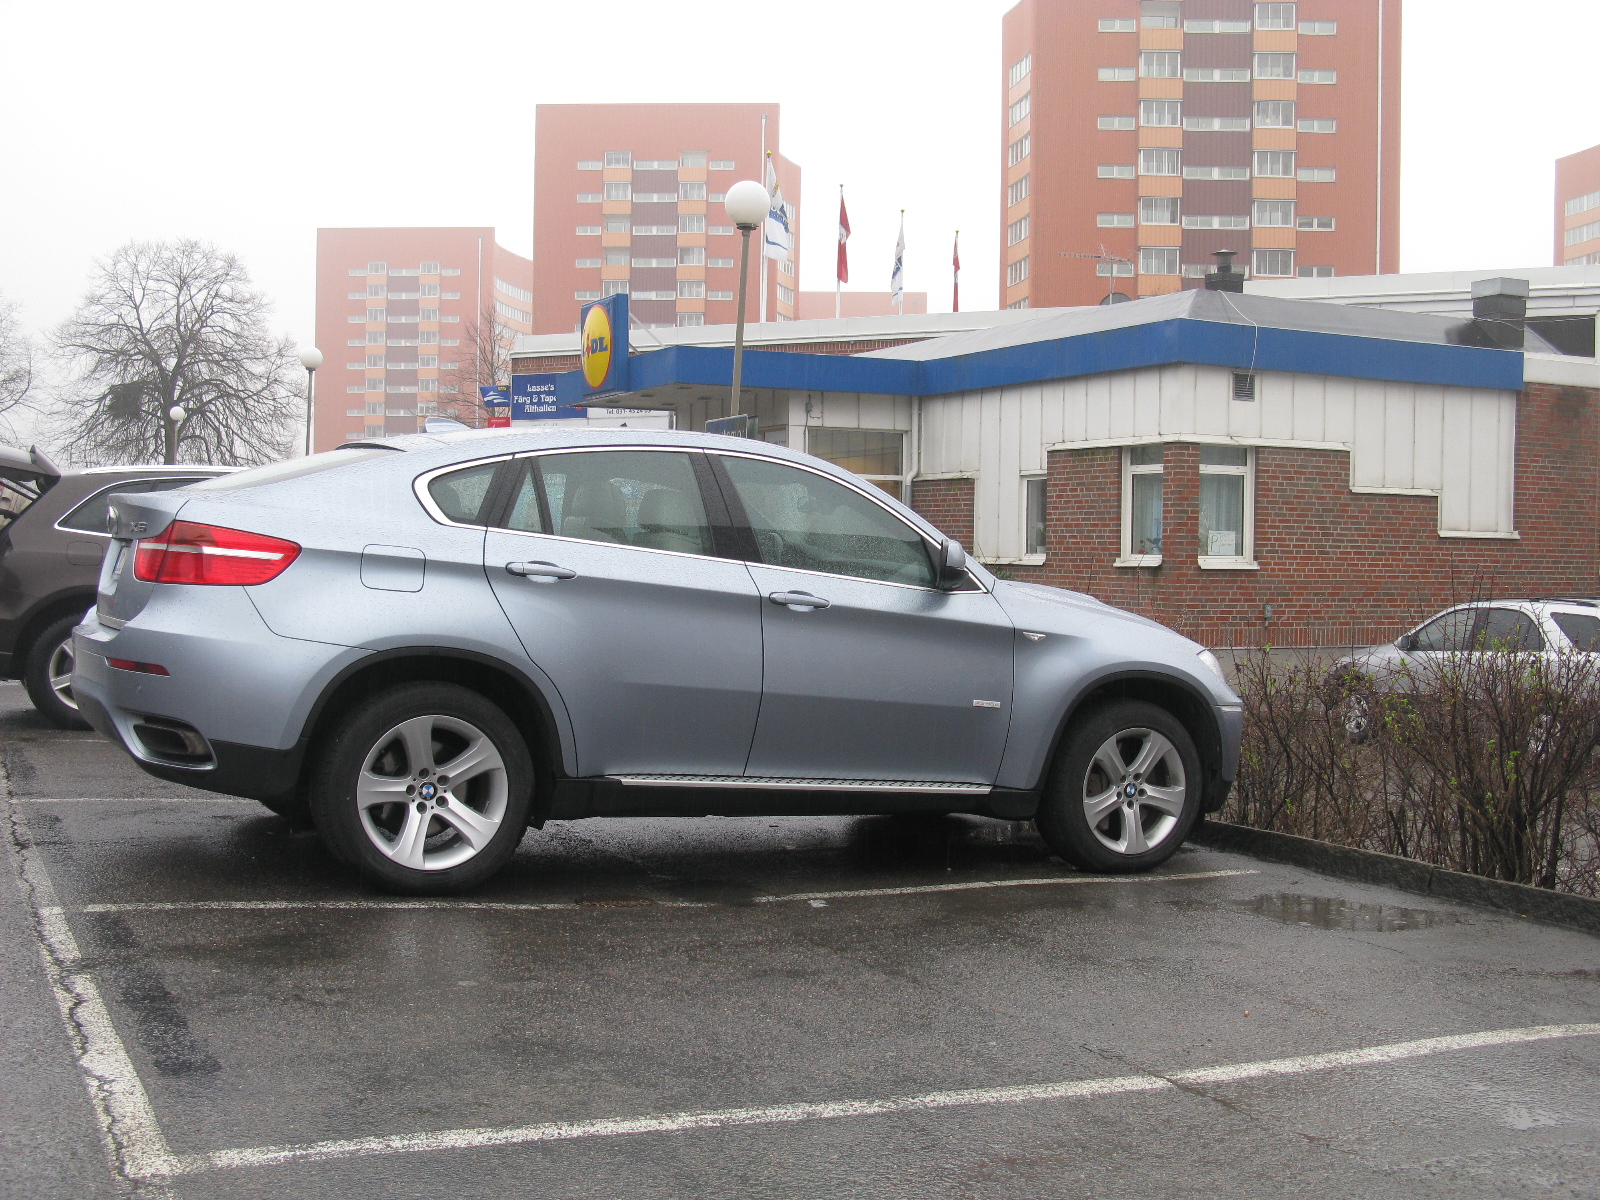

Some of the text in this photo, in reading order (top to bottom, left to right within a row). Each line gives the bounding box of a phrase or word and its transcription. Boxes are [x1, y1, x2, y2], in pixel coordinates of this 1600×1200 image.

[526, 383, 555, 391] Lasse's
[513, 395, 531, 405] Färg
[532, 394, 538, 403] &
